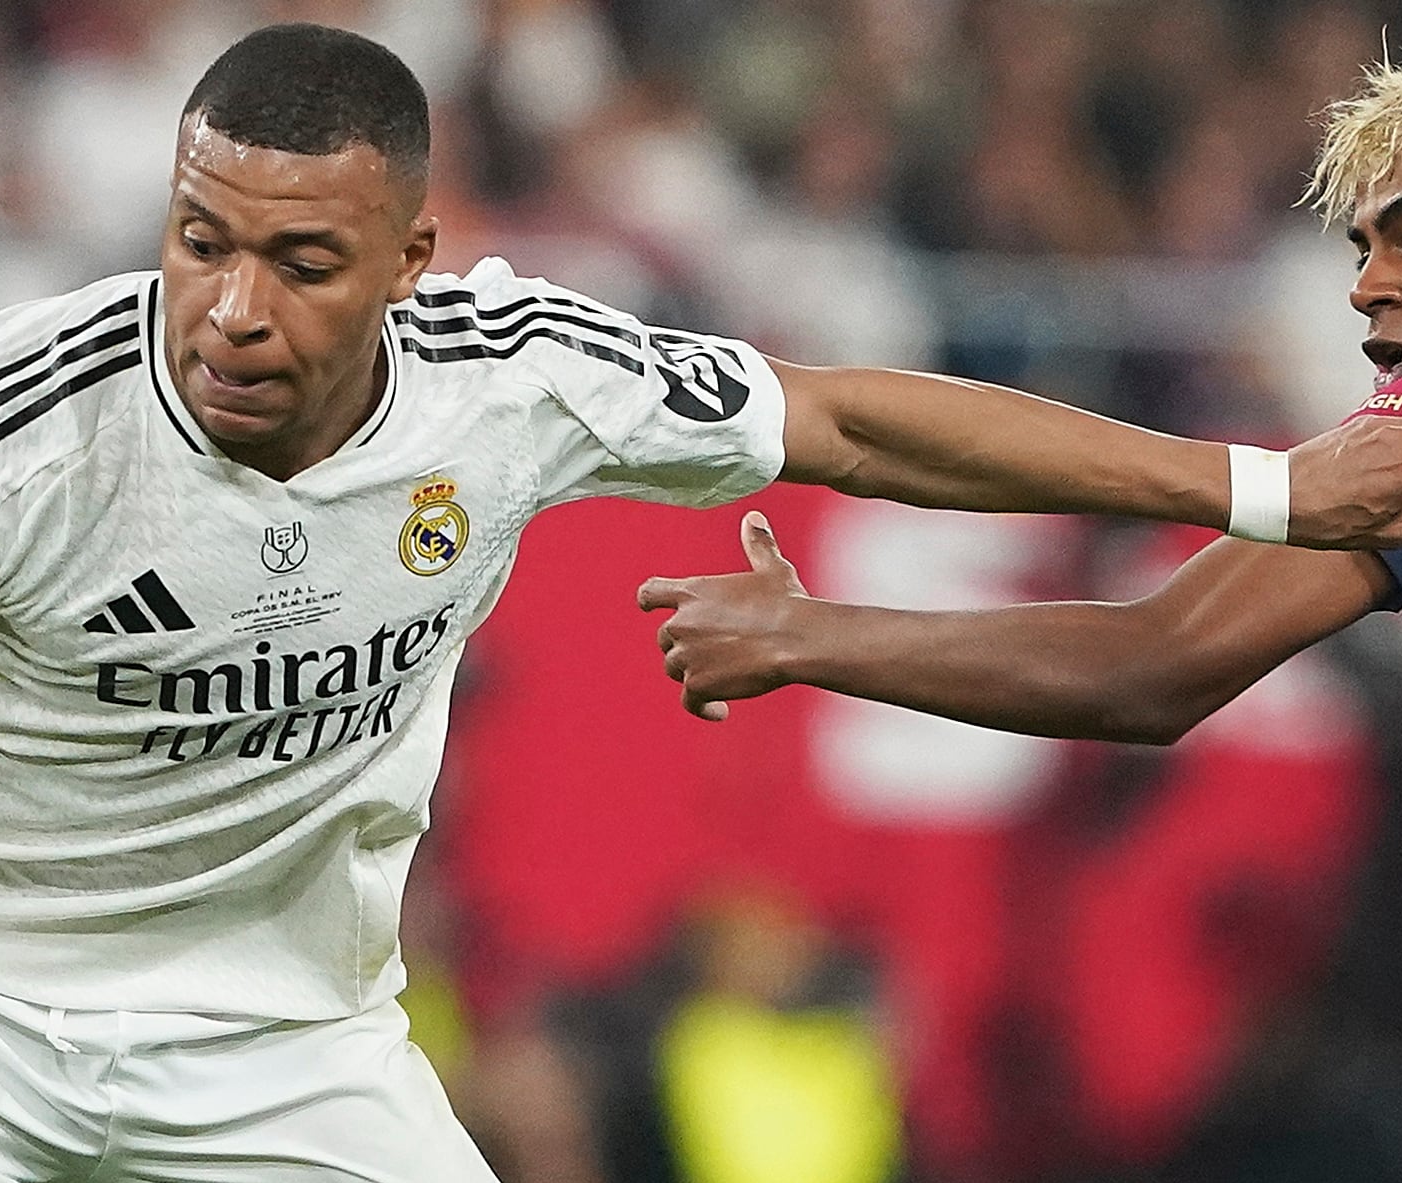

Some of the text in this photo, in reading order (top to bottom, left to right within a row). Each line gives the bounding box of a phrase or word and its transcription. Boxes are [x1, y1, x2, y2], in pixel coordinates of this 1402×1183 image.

[231, 608, 261, 620] COPA
[256, 585, 316, 603] FINAL
[98, 601, 455, 714] Emirates
[140, 682, 402, 762] FLY BETTER
